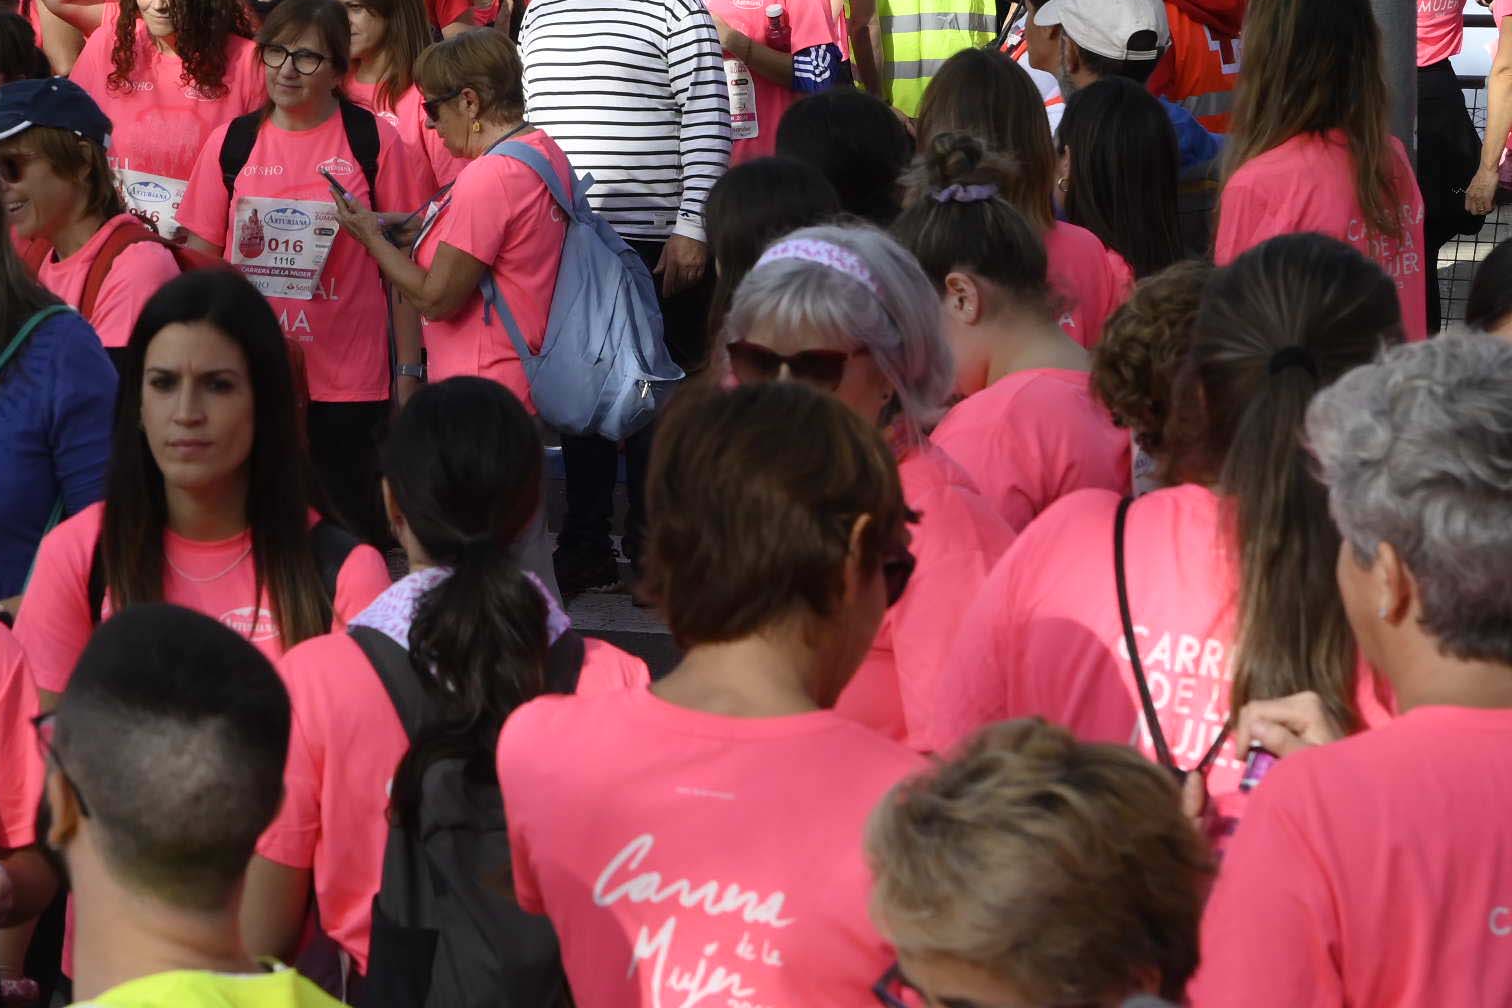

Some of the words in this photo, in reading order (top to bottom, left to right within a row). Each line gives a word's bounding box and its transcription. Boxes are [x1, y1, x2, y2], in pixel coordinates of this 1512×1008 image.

[243, 165, 284, 177] OYSHO
[268, 214, 308, 226] ASTURIANA
[268, 238, 304, 253] 016
[273, 255, 296, 266] 1116
[241, 266, 271, 275] CARRERA
[1148, 671, 1197, 715] DE
[592, 833, 797, 928] Carrera
